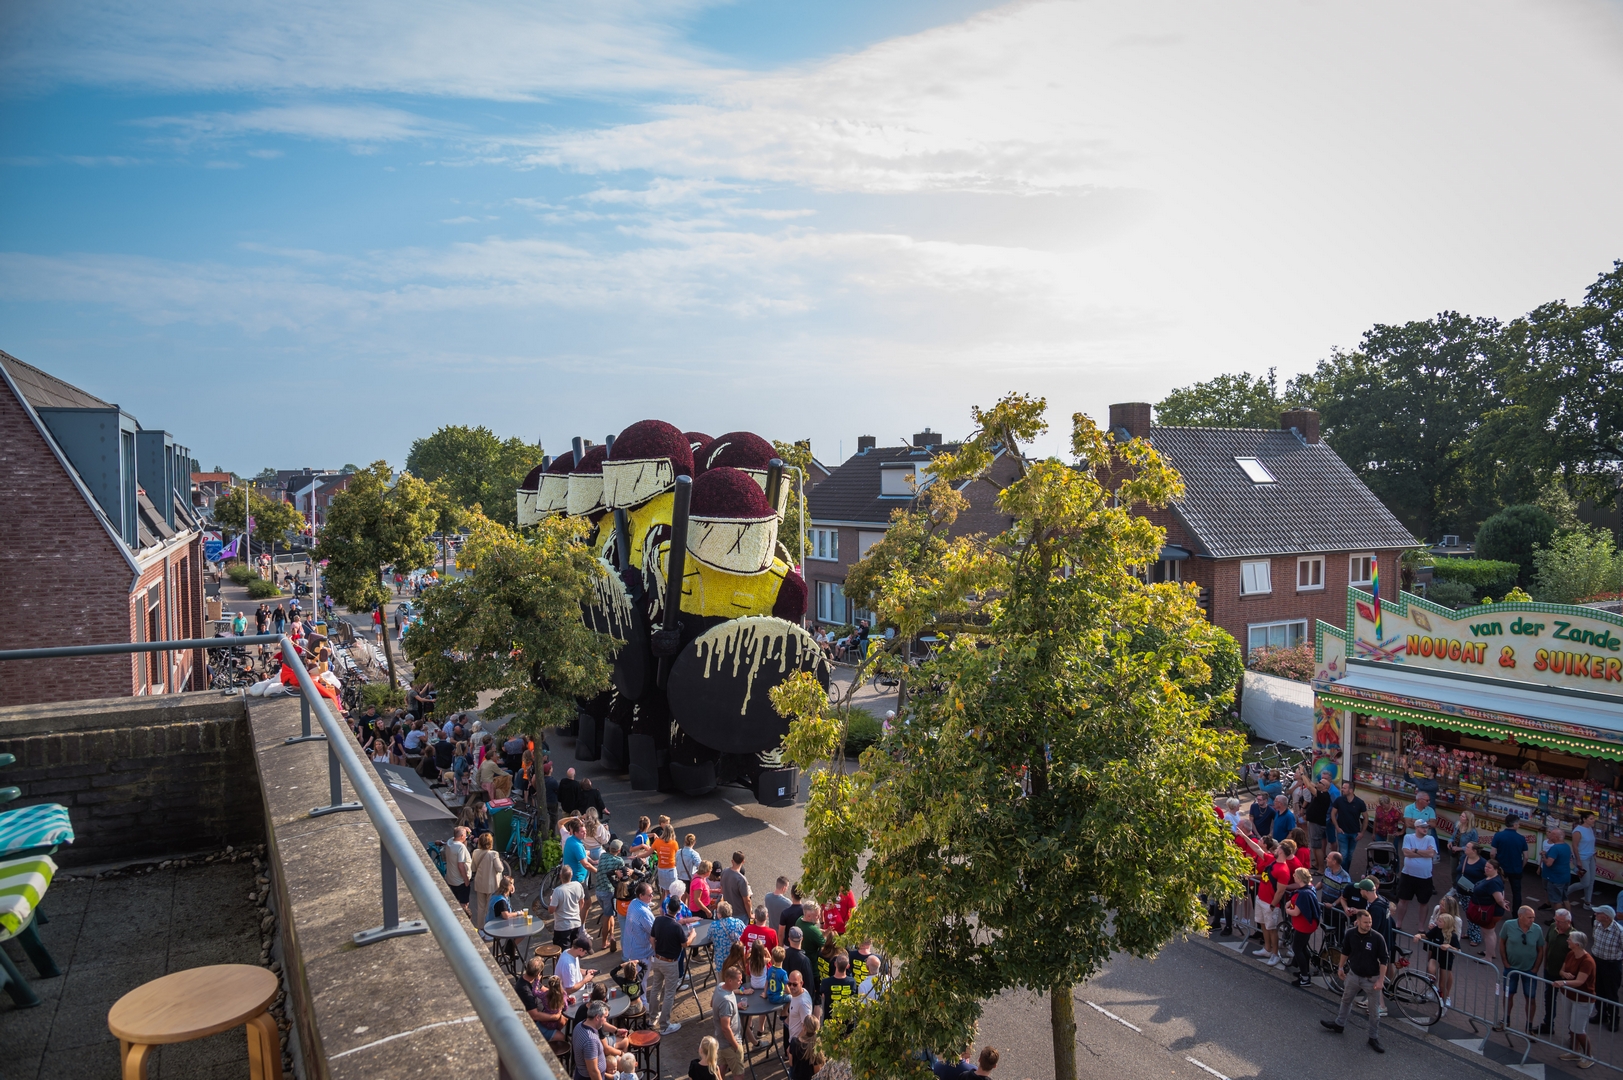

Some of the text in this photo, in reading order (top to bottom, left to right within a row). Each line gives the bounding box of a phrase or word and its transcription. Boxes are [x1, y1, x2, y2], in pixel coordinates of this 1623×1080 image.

[1469, 616, 1621, 651] van der Zande
[1406, 634, 1622, 682] NOUGAT & SUIKER
[1360, 689, 1378, 700] VAN
[769, 979, 777, 993] 8
